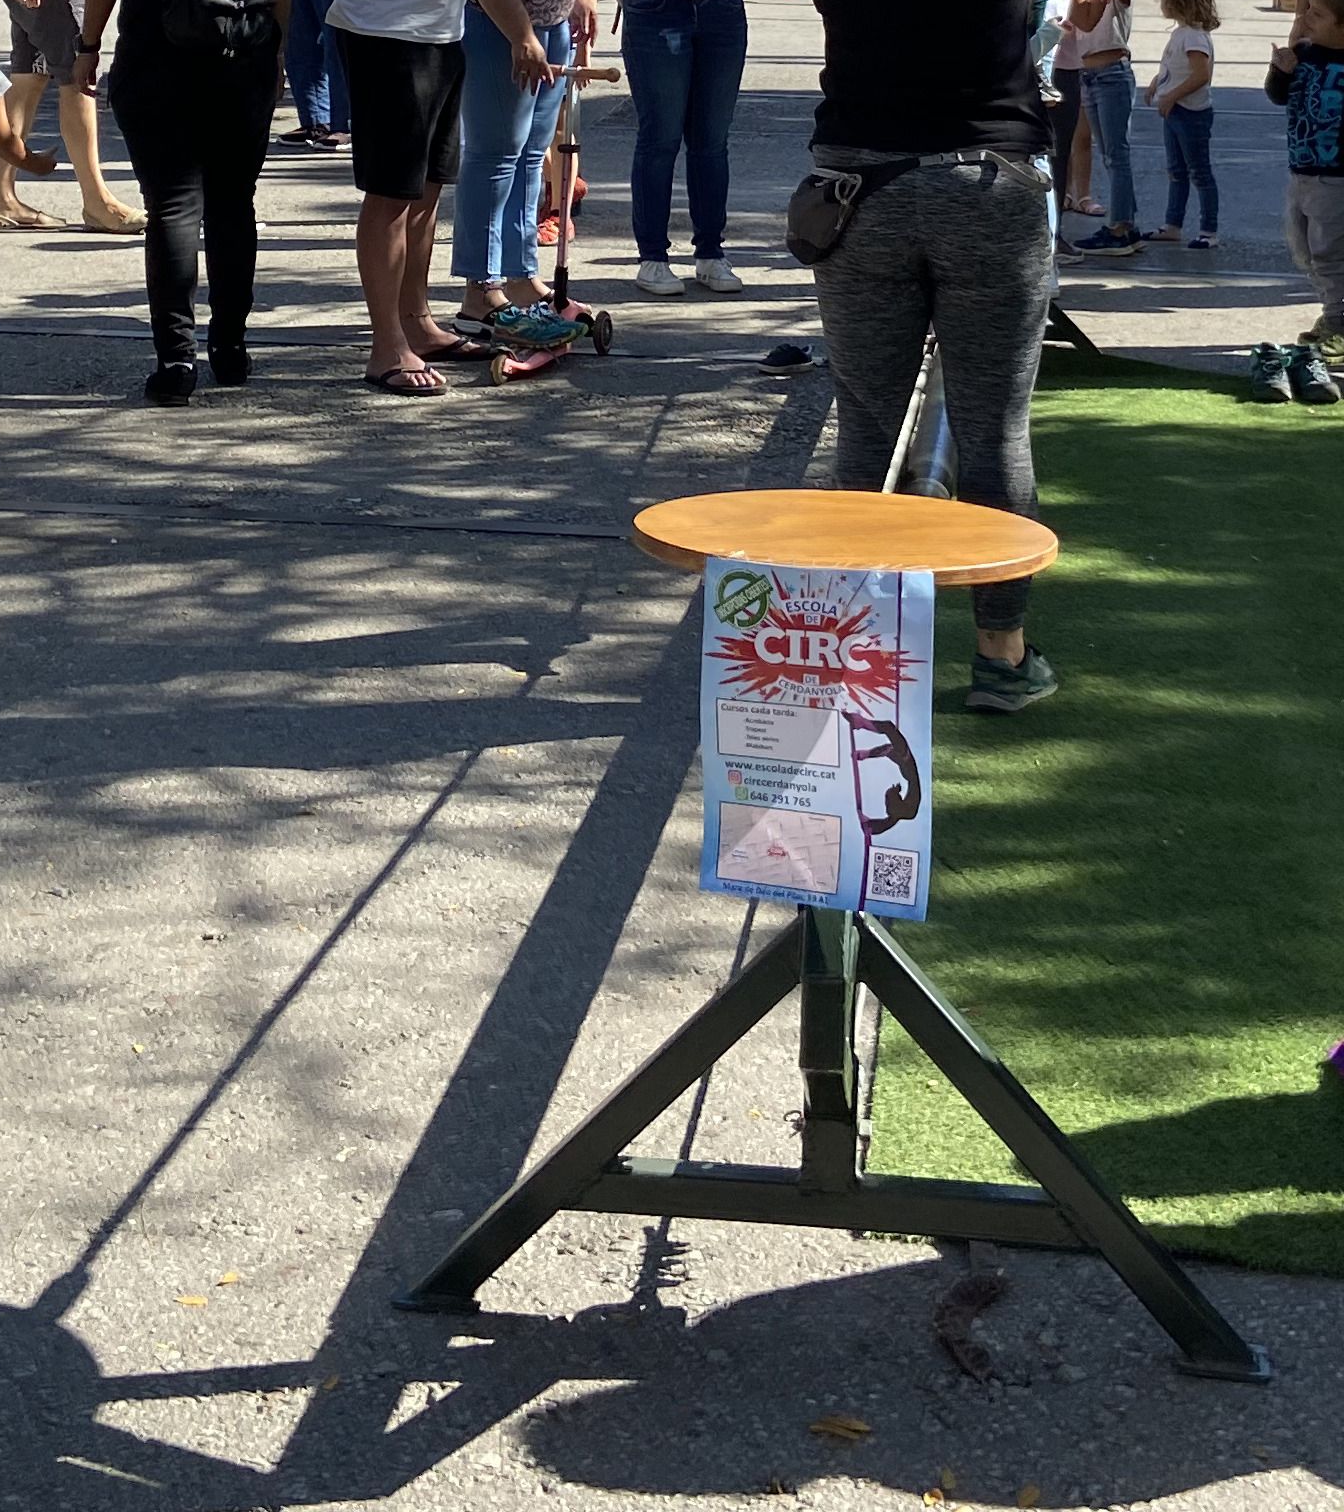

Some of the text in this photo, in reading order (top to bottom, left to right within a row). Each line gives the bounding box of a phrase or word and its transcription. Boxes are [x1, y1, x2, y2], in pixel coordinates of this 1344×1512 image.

[785, 600, 838, 616] ESCOLA
[805, 615, 820, 624] DE
[754, 627, 872, 672] CIRC
[778, 678, 845, 696] CERDANYOLA
[804, 675, 818, 684] DE
[720, 703, 798, 717] Cursos cada tarda:
[724, 760, 837, 781] www.escoladecirc.cat
[743, 775, 818, 794] circcerdanyola
[749, 790, 812, 807] 646 291 765
